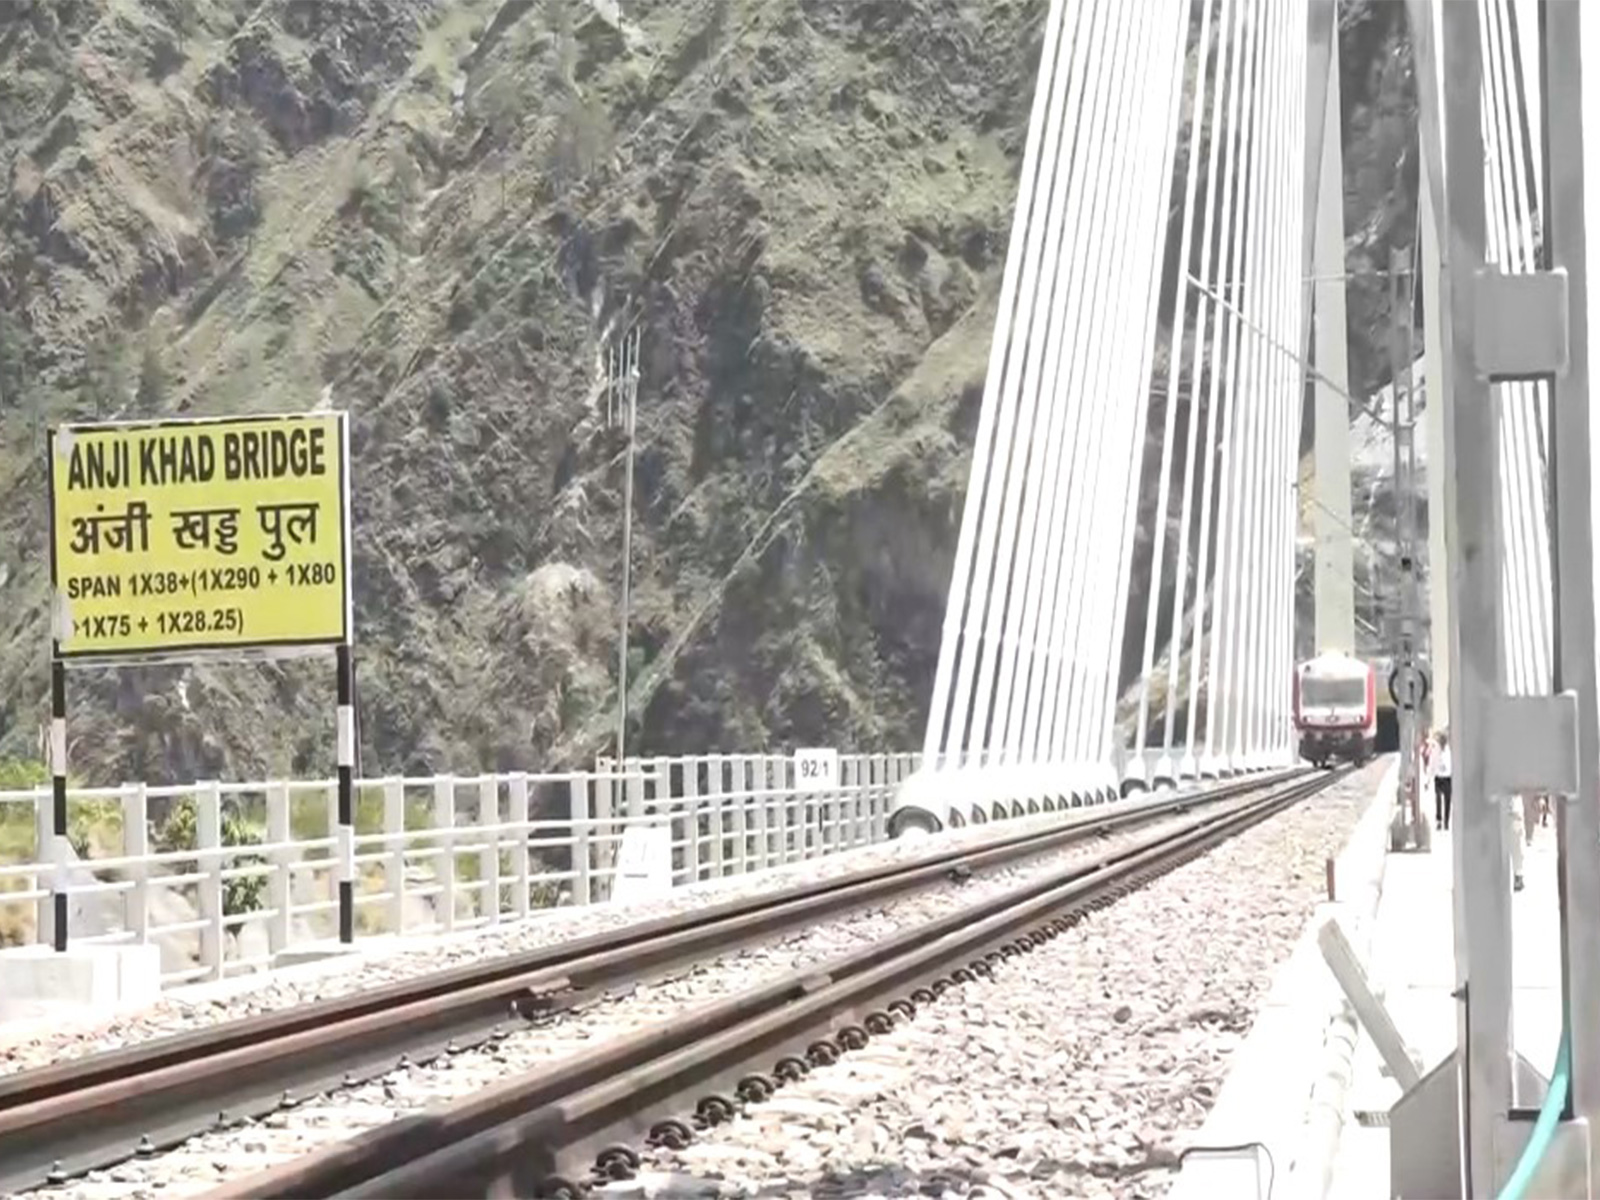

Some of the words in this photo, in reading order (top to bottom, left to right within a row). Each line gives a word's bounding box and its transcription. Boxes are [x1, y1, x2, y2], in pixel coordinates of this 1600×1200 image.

[68, 440, 130, 490] ANJI
[139, 435, 215, 486] KHAD
[225, 428, 326, 481] BRIDGE
[70, 501, 153, 554] अंजी
[256, 502, 320, 562] पुल
[67, 577, 121, 599] SPAN
[266, 569, 280, 584] +
[285, 562, 336, 586] 1X80
[137, 616, 148, 633] +
[155, 608, 244, 636] 1X28.25)
